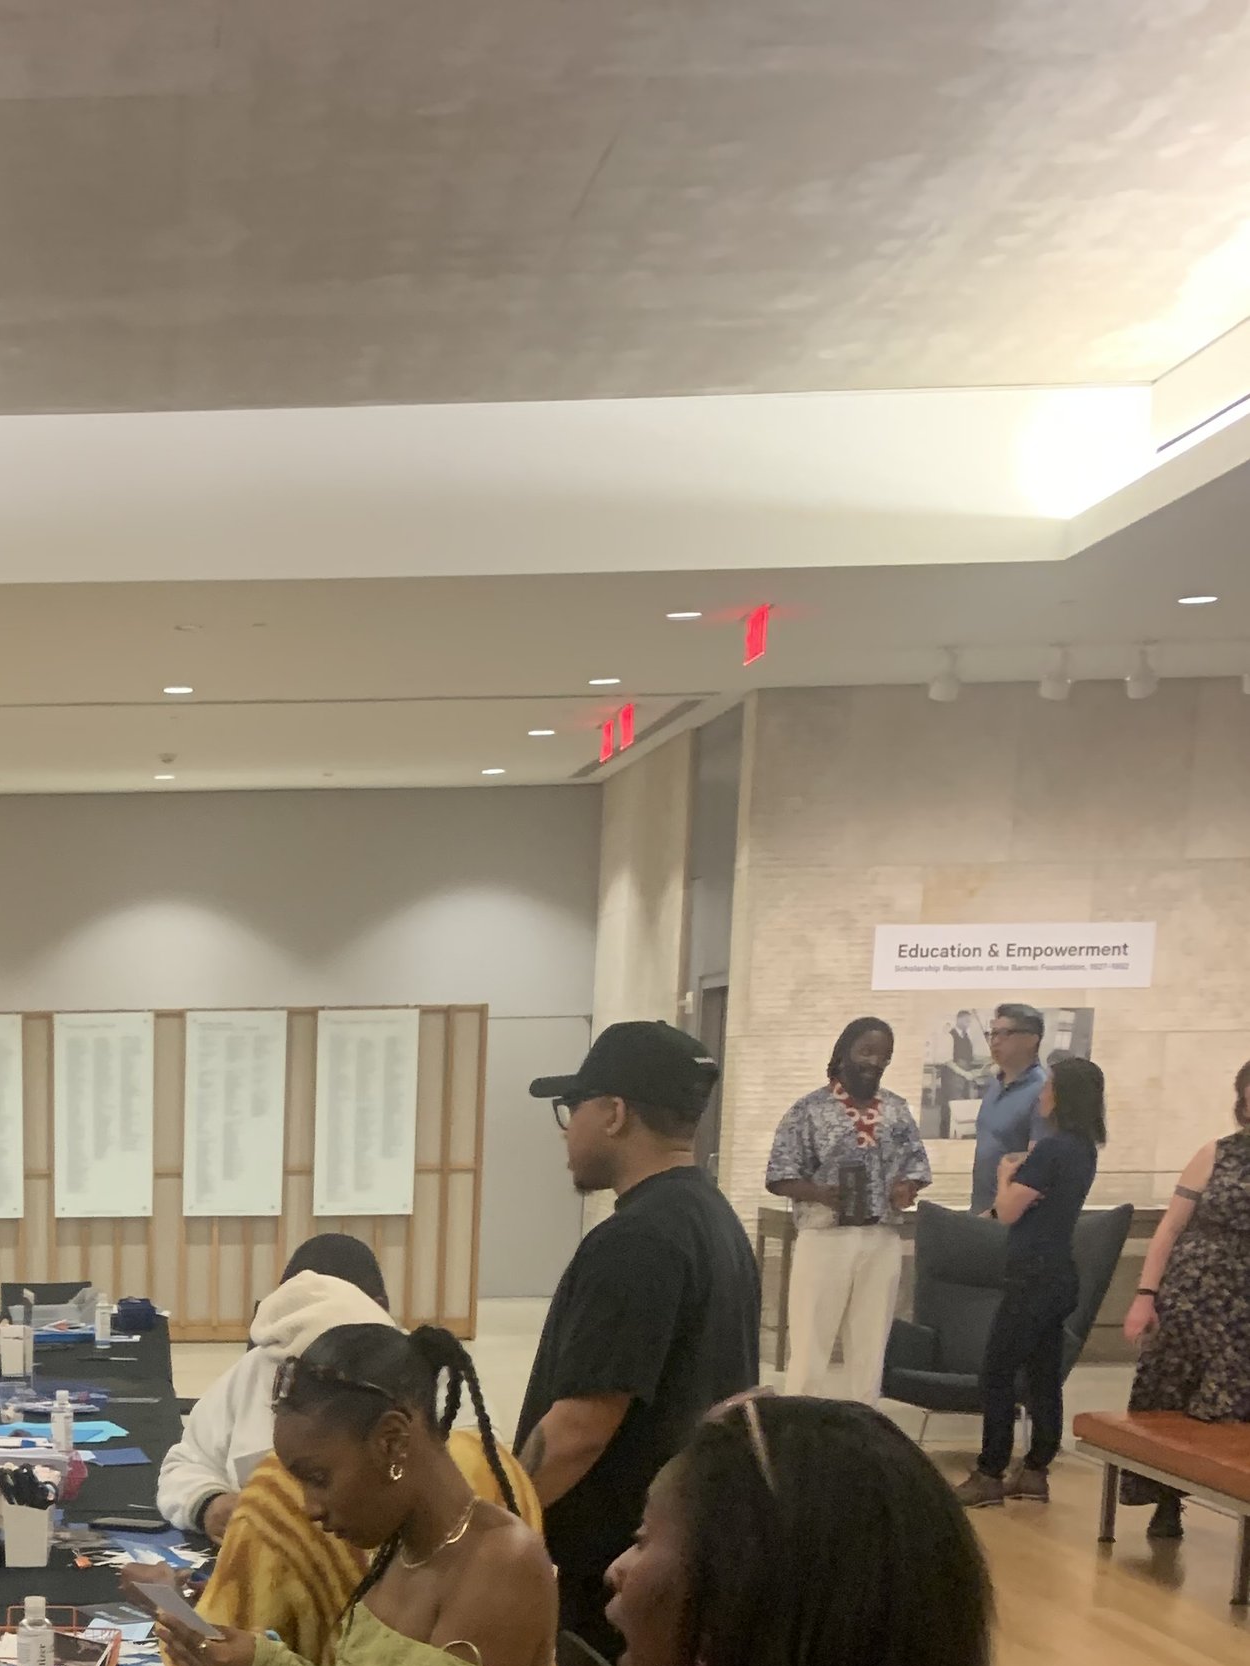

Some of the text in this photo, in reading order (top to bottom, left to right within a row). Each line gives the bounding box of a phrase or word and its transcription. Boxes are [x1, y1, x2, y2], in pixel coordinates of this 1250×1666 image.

[898, 943, 1129, 960] Education & Empowerment
[894, 965, 940, 973] Scholarship
